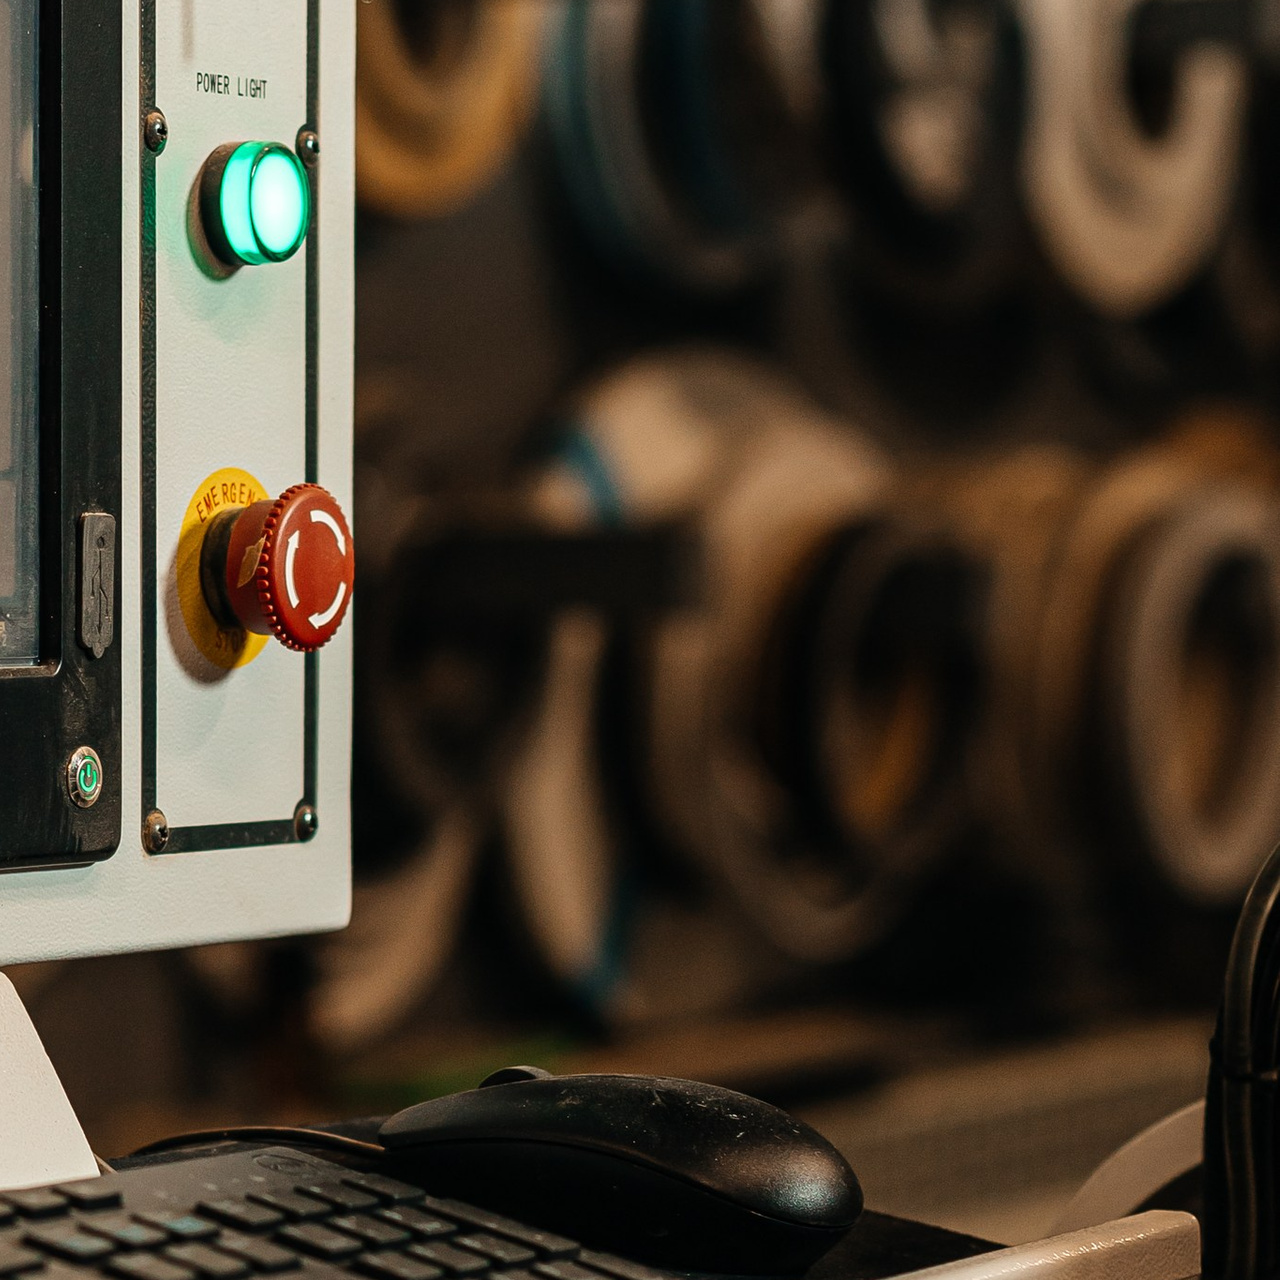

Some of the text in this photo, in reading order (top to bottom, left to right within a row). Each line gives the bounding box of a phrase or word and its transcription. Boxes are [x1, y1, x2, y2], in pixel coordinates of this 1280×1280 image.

[196, 71, 268, 99] POWER LIGHT
[196, 482, 262, 523] EMERGEN
